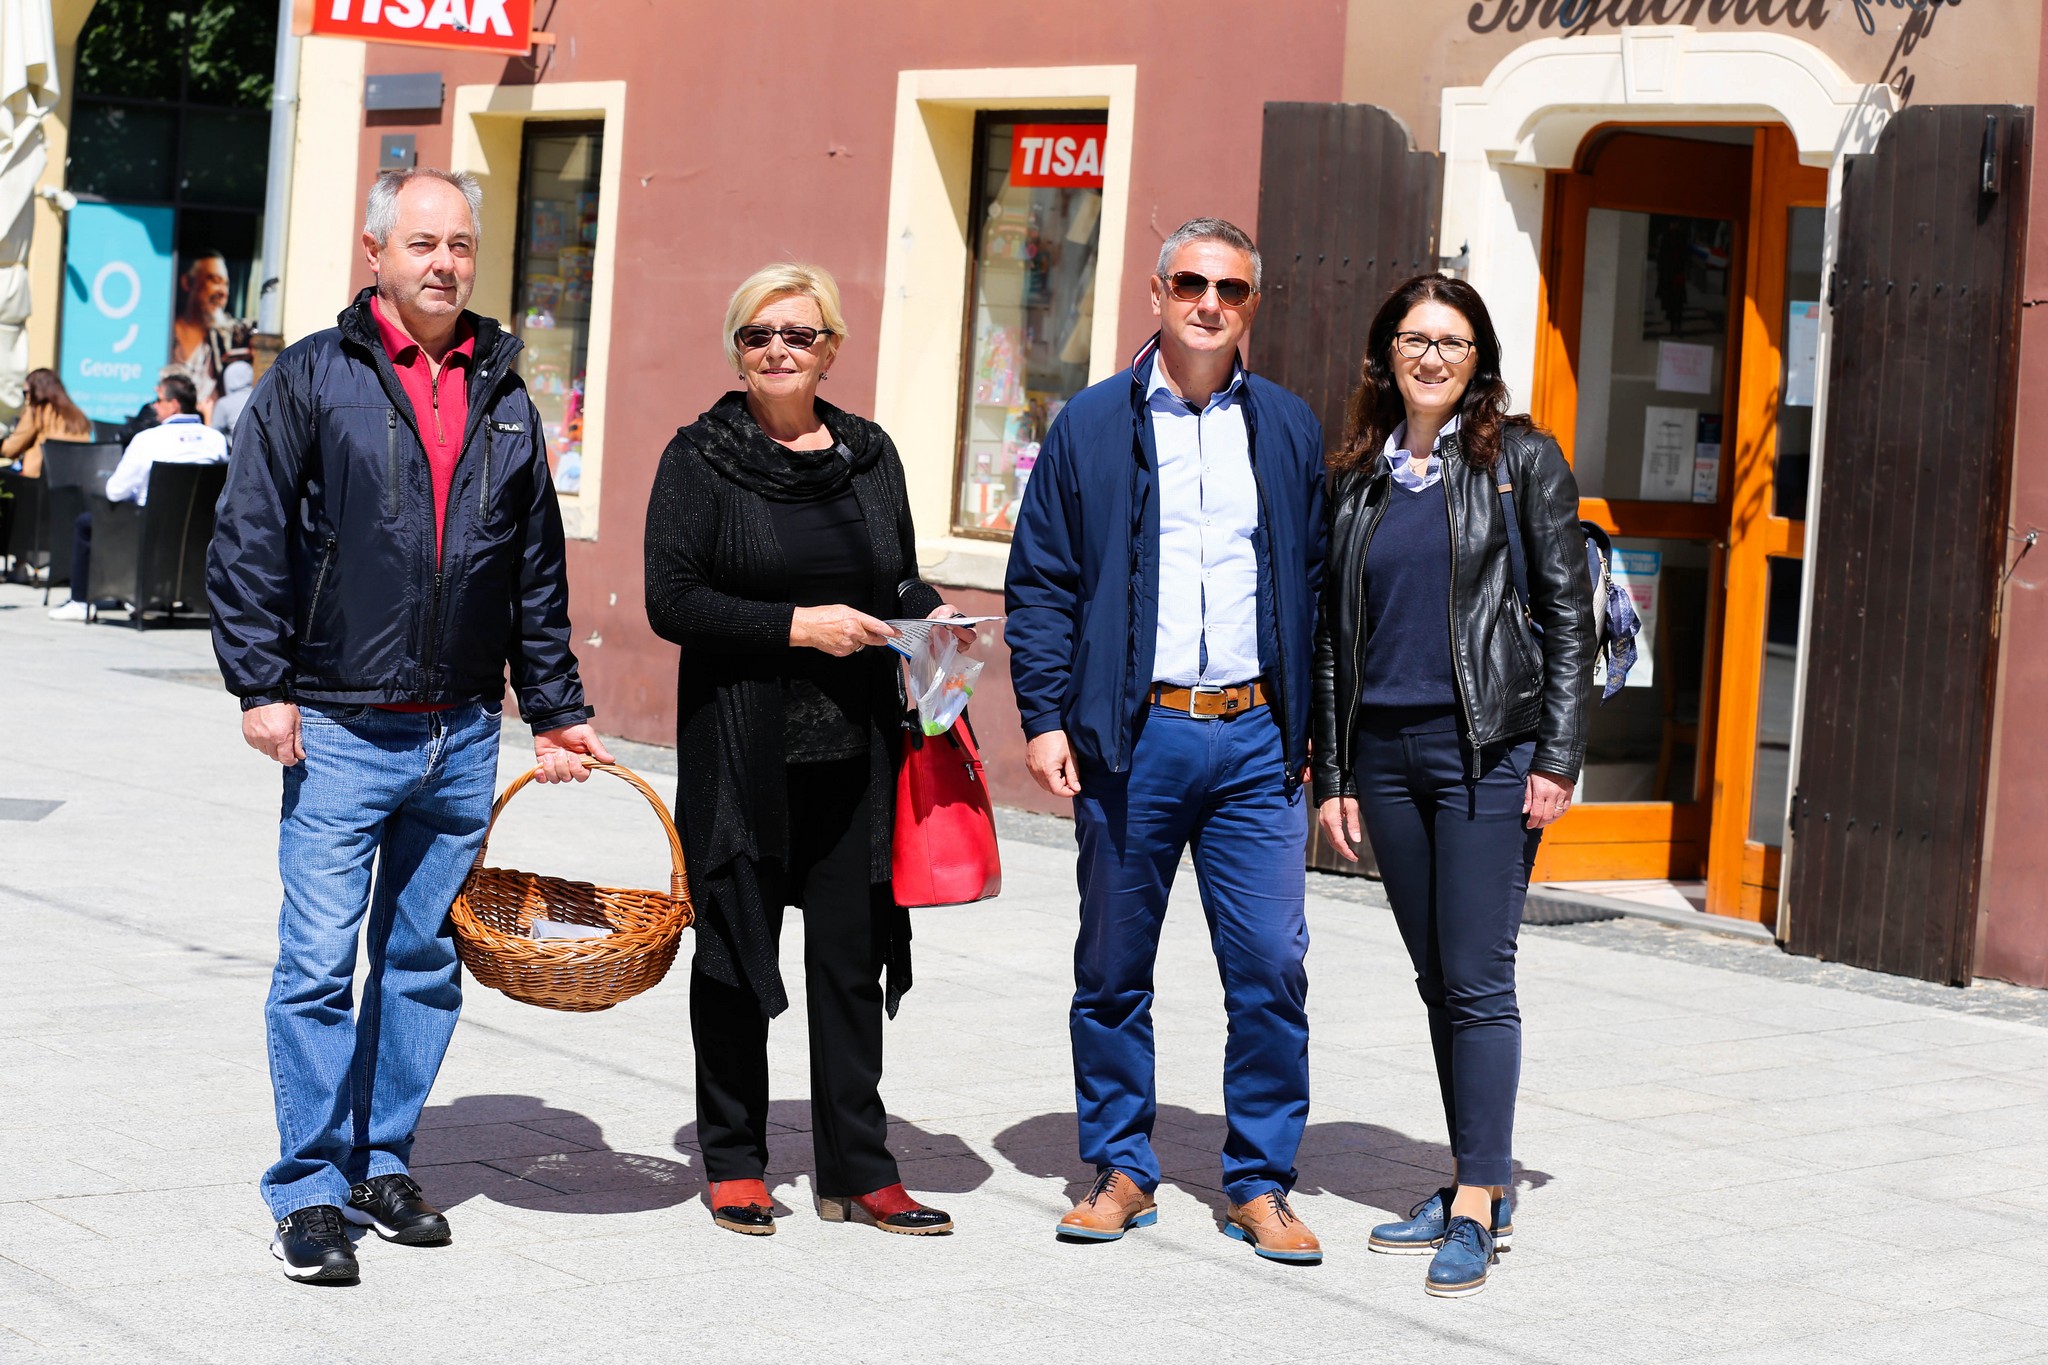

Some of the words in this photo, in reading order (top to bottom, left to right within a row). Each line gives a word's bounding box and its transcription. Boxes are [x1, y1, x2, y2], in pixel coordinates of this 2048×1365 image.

[1020, 136, 1107, 177] TISA
[80, 358, 142, 382] George
[498, 423, 520, 431] FILA
